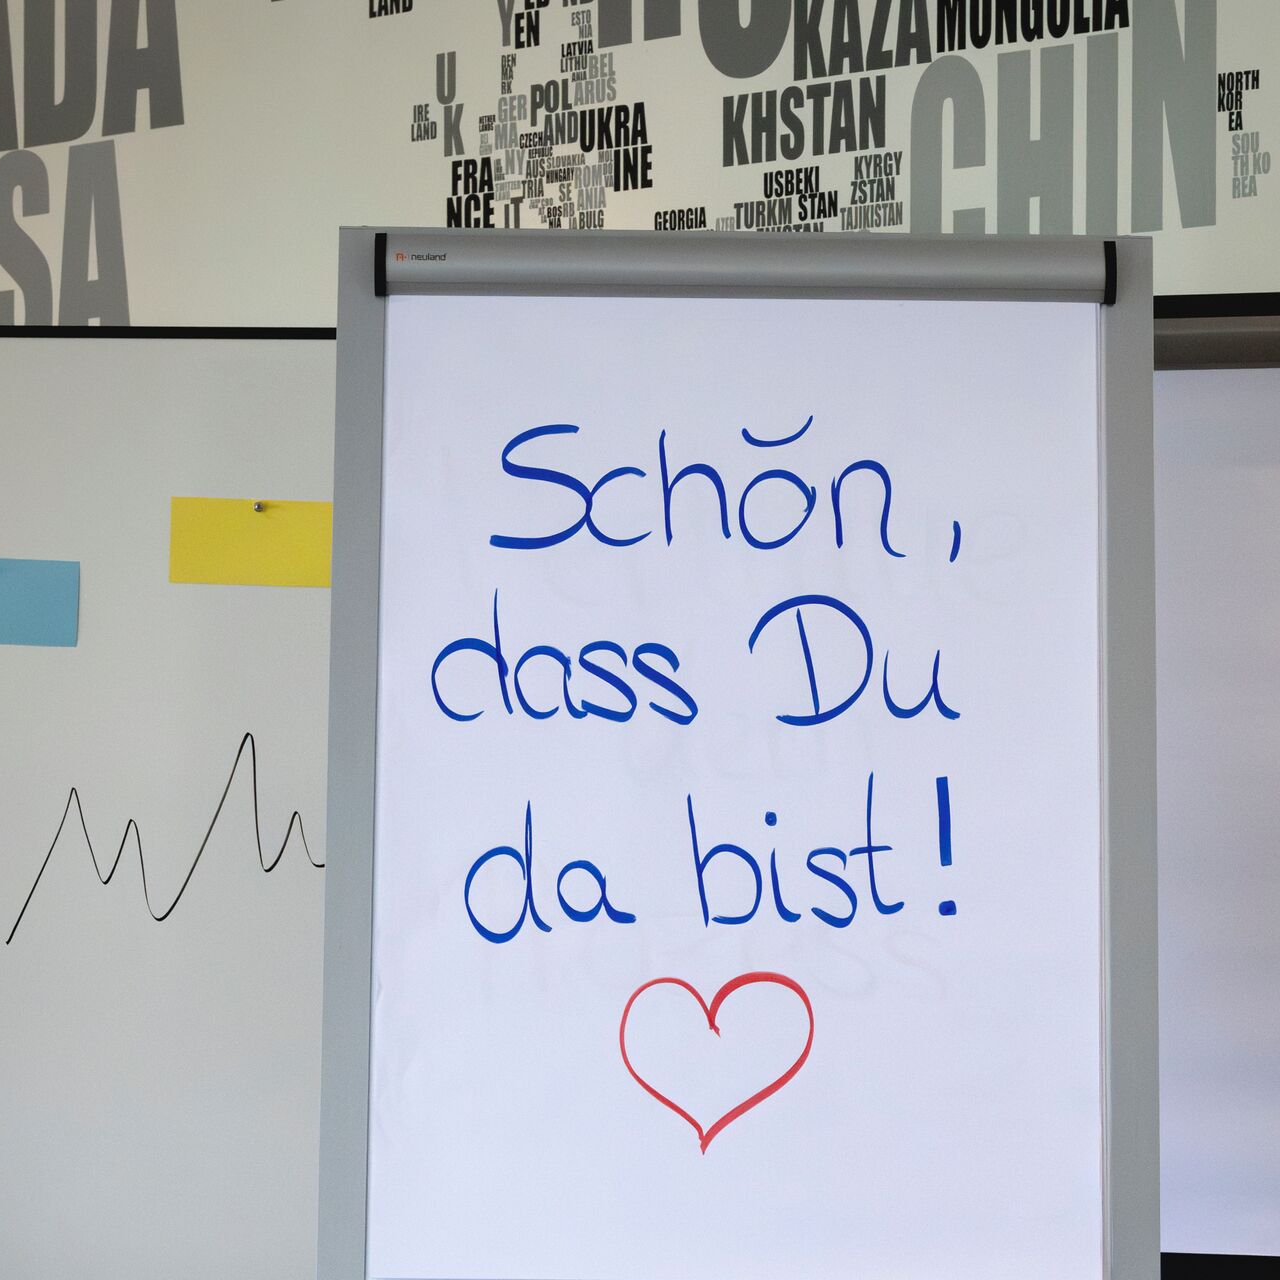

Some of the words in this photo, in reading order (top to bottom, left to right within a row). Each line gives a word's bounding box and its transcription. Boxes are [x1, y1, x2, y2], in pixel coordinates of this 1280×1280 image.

[571, 9, 591, 26] ESTO
[561, 39, 594, 58] LATVIA
[793, 0, 932, 81] KAZA
[501, 53, 517, 68] DEN
[560, 55, 587, 73] LITHU
[588, 52, 616, 79] BEL
[573, 77, 617, 106] ARUS
[1217, 69, 1260, 93] NORTH
[413, 103, 430, 123] IRE
[498, 94, 527, 122] GER
[530, 78, 572, 127] POL
[1217, 90, 1243, 112] KOR
[543, 110, 578, 146] AND
[579, 101, 648, 153] UKRA
[722, 74, 886, 167] KHSTAN
[910, 0, 1217, 235] CHIN
[1228, 110, 1243, 131] EA
[411, 121, 437, 142] LAND
[494, 122, 519, 150] MA
[519, 131, 543, 149] CZECH
[1231, 131, 1260, 155] SOU
[505, 148, 526, 175] NY
[528, 146, 553, 159] REPUBLIC
[546, 153, 586, 169] SLOVAKIA
[1231, 154, 1250, 177] TH
[1253, 151, 1271, 176] KO
[451, 156, 494, 196] FRA
[525, 158, 546, 179] AUS
[545, 167, 574, 184] HUNGARY
[574, 164, 602, 189] ROM
[613, 144, 653, 192] INE
[854, 151, 903, 180] KYRGY
[558, 182, 572, 202] SE
[763, 166, 820, 199] USBEKI
[850, 176, 895, 205] ZSTAN
[1231, 175, 1258, 199] REA
[446, 192, 496, 229] NCE
[577, 186, 607, 211] ANIA
[797, 190, 838, 221] STAN
[546, 205, 562, 218] BOS
[579, 209, 604, 229] BULG
[654, 206, 707, 230] GEORGIA
[733, 197, 792, 229] TURKM
[839, 201, 903, 231] TAJIKISTAN
[410, 252, 448, 261] neuland
[430, 587, 699, 726] dass
[748, 593, 960, 727] Du
[463, 800, 637, 944] da
[686, 771, 957, 929] bist!
